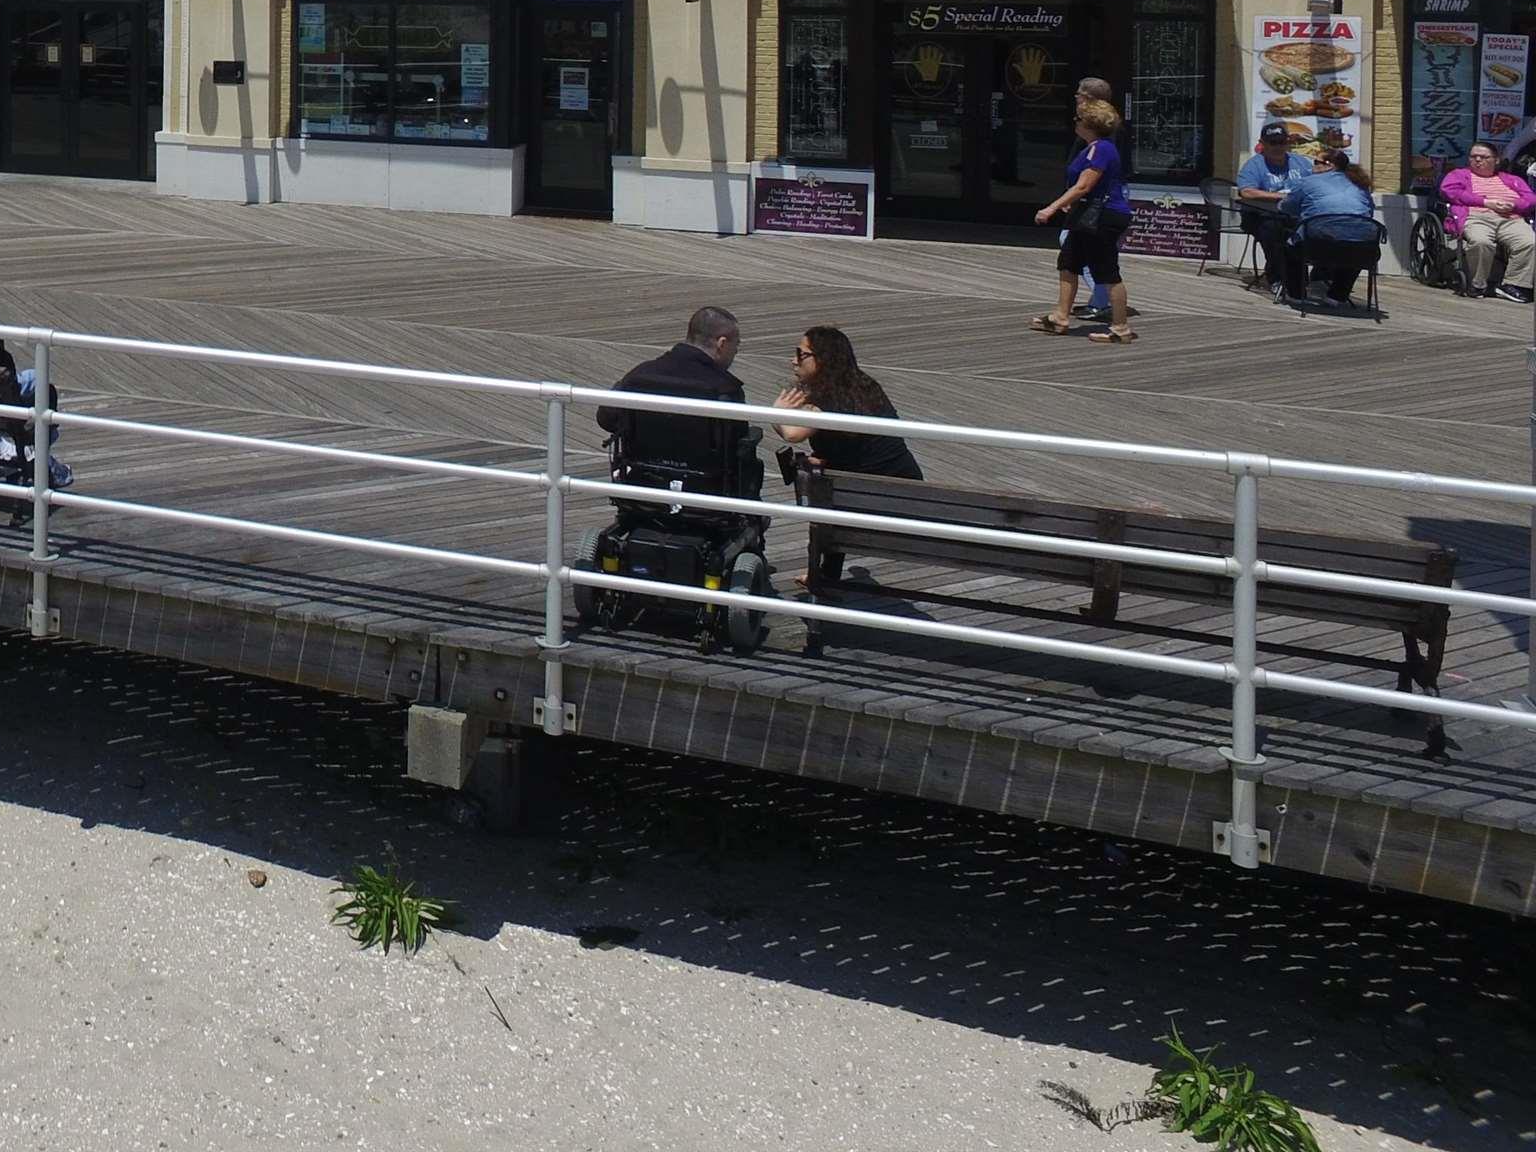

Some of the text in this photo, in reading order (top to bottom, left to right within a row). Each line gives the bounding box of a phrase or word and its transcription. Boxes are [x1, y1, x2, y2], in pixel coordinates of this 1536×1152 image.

[1424, 0, 1470, 12] SHRIMP
[908, 5, 1063, 31] $5 Special Reading
[1264, 21, 1354, 39] PIZZA
[1488, 42, 1524, 51] SPECIAL
